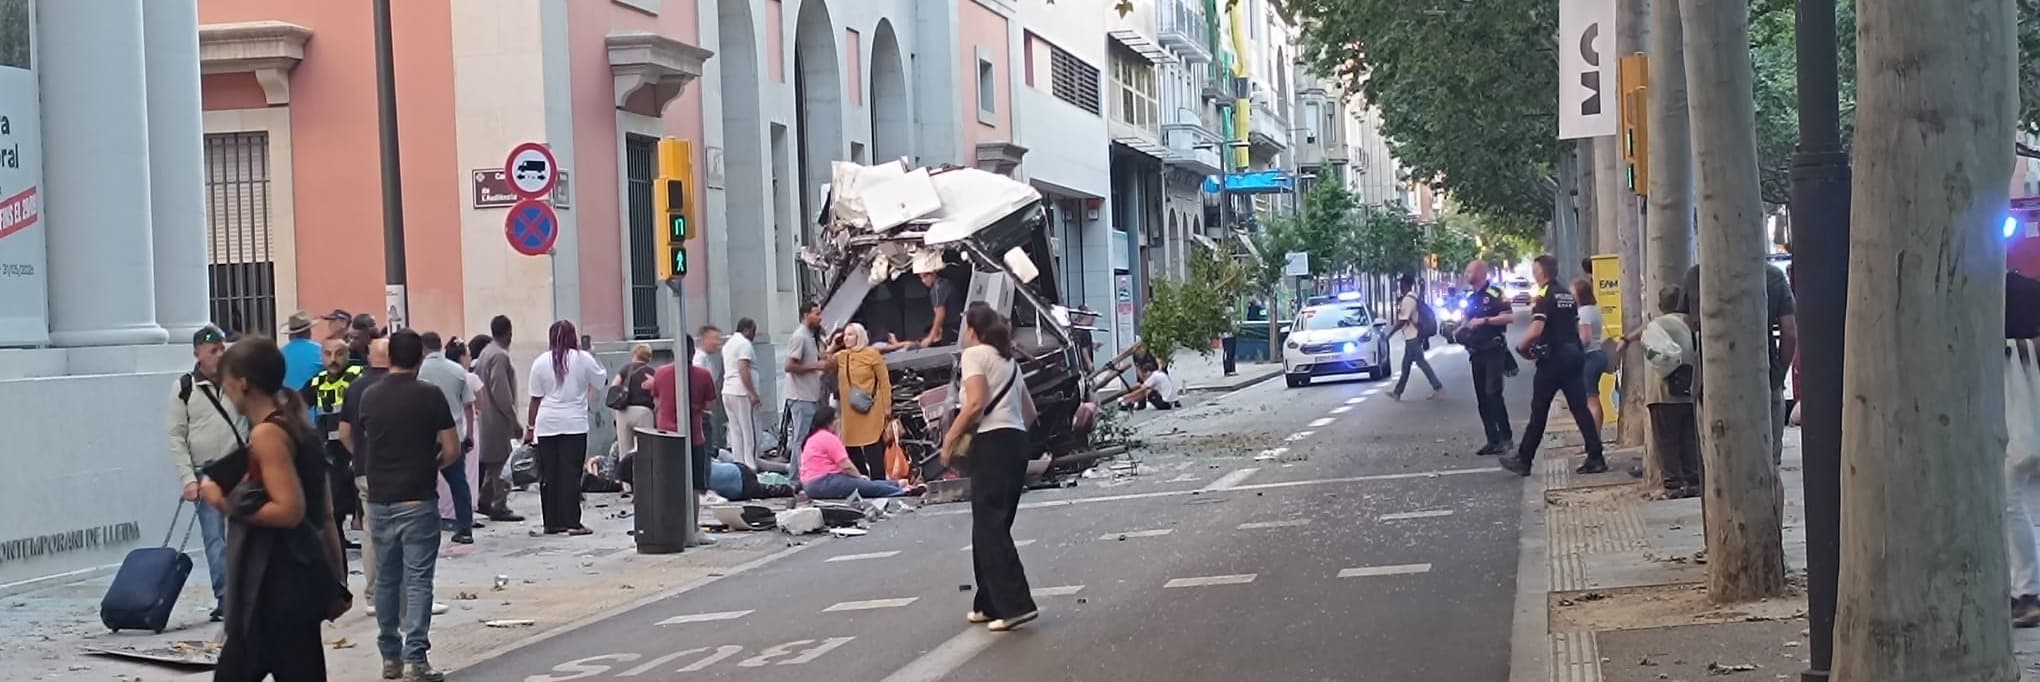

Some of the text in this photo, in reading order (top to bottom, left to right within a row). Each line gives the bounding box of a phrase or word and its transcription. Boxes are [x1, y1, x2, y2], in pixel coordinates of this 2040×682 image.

[0, 144, 19, 168] ral
[85, 526, 101, 547] DE
[102, 520, 141, 544] LLEIDA
[523, 636, 857, 682] BUS
